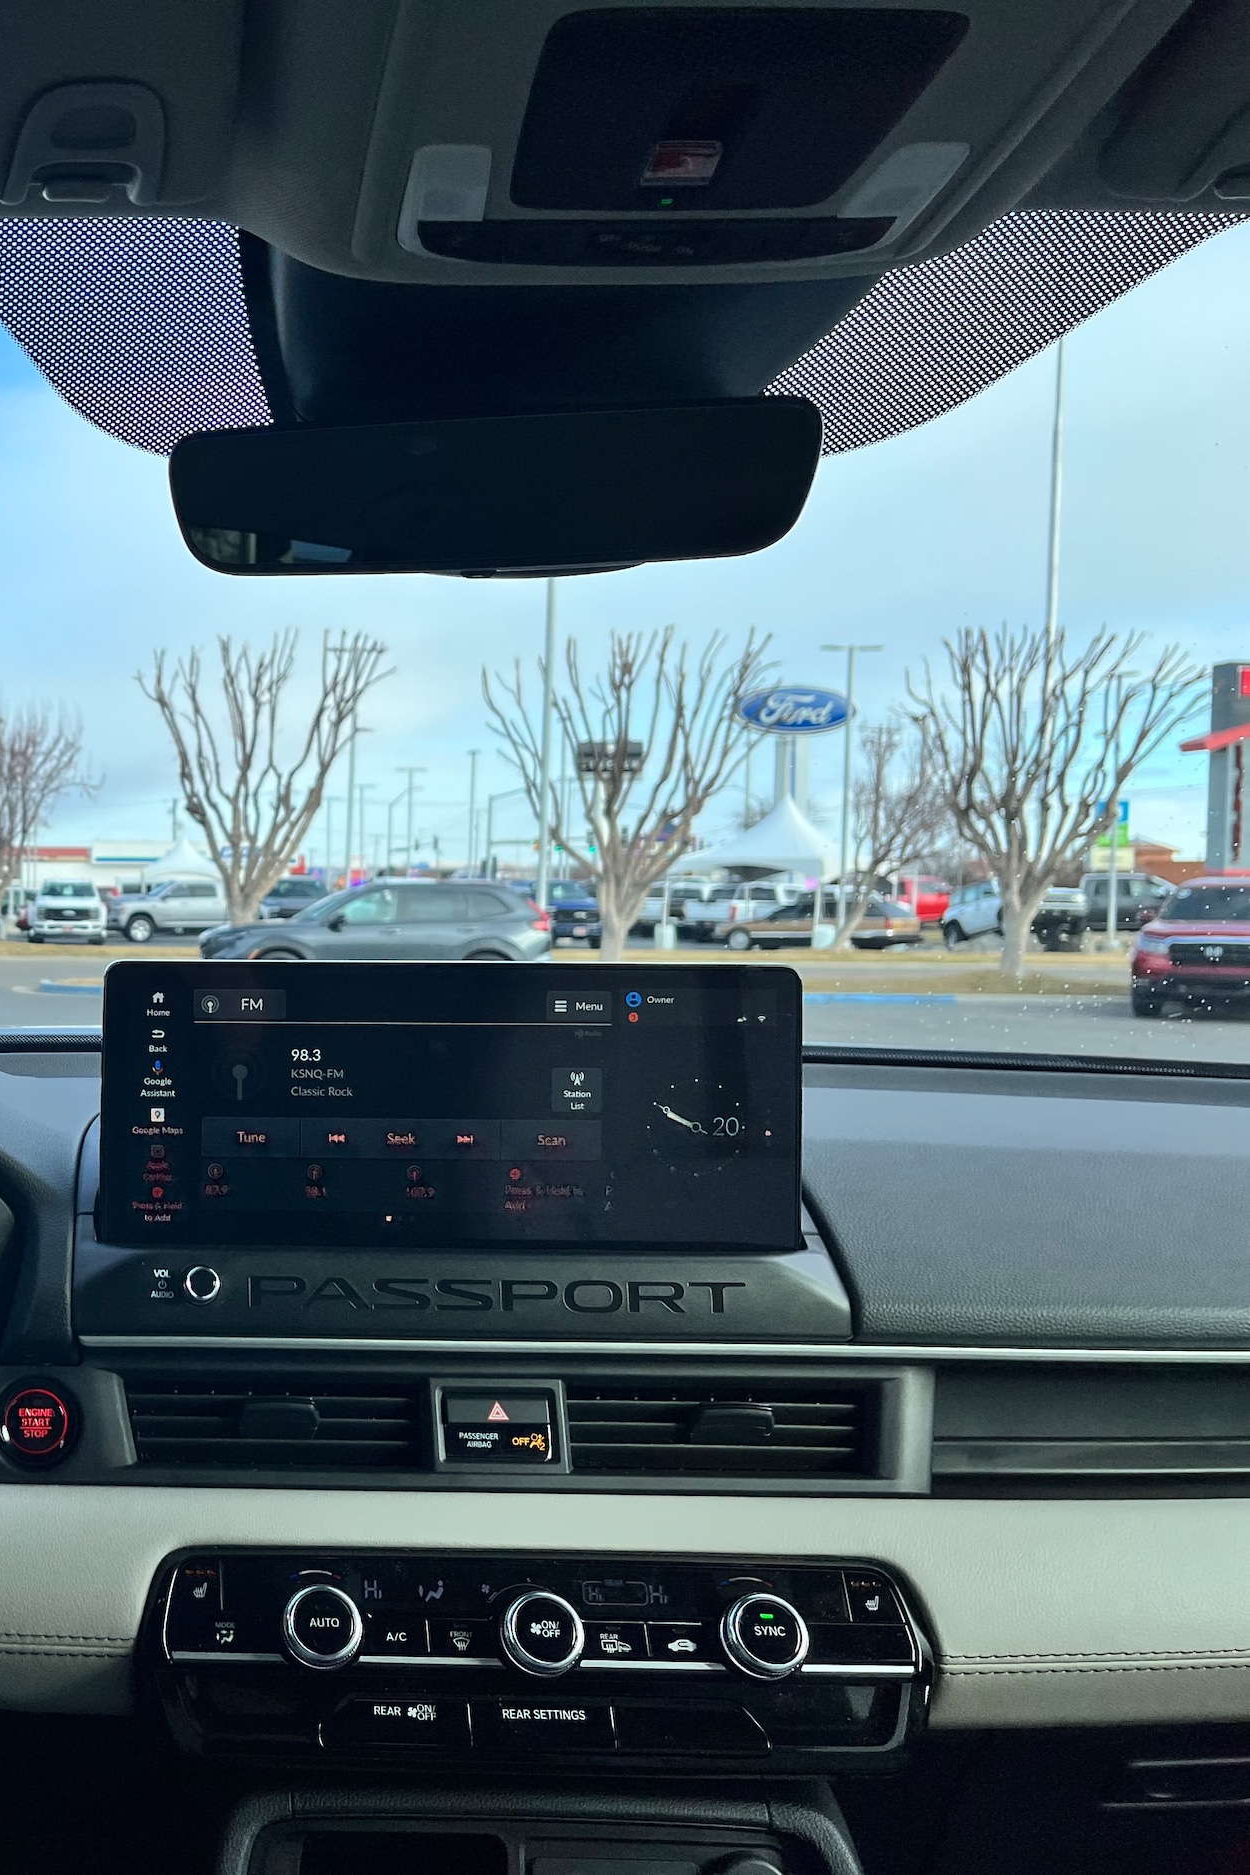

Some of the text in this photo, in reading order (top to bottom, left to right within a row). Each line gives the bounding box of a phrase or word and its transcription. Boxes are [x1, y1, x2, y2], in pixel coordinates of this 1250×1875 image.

[759, 693, 834, 724] Ford
[240, 997, 264, 1012] FM
[646, 995, 675, 1004] Owner
[575, 1001, 604, 1012] Menu
[146, 1008, 171, 1018] Home
[148, 1044, 168, 1054] Back
[290, 1048, 322, 1063] 98.3
[290, 1068, 344, 1081] KSNQ-FM
[143, 1077, 173, 1088] Google
[139, 1089, 176, 1099] Assistant
[290, 1085, 353, 1097] Classic Rock
[562, 1089, 592, 1099] Station
[570, 1101, 585, 1110] List
[712, 1116, 740, 1136] 20
[131, 1126, 184, 1137] Google Maps
[236, 1130, 266, 1144] Tune
[386, 1132, 417, 1146] Seek
[537, 1134, 567, 1147] Scan
[152, 1269, 171, 1278] VOL
[151, 1290, 175, 1299] AUDIO
[246, 1275, 745, 1314] PASSPORT
[18, 1408, 54, 1417] ENGINE
[21, 1418, 51, 1427] START
[23, 1429, 48, 1438] STOP
[458, 1431, 499, 1441] PASSENGER
[466, 1440, 492, 1449] AIRBAG
[511, 1437, 530, 1446] OFF
[214, 1621, 236, 1629] MODE
[309, 1616, 340, 1629] AUTO
[541, 1620, 560, 1630] ON/
[449, 1631, 473, 1639] FRONT
[541, 1629, 561, 1638] OFF
[753, 1625, 788, 1638] SYNC
[385, 1631, 408, 1643] A/C
[599, 1633, 619, 1641] REAR
[372, 1705, 402, 1717] REAR
[502, 1708, 587, 1722] REAR SETTINGS
[416, 1712, 438, 1723] OFF
